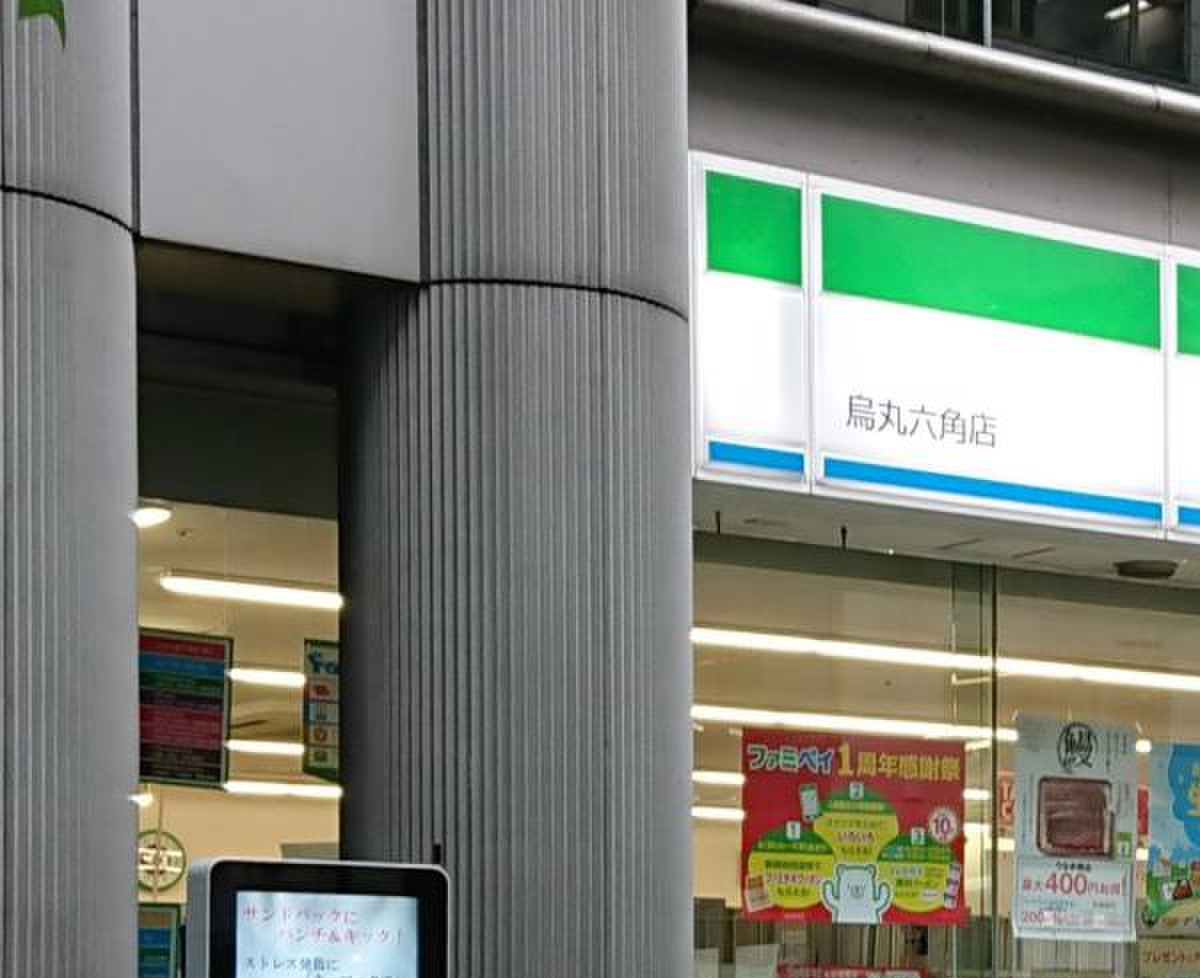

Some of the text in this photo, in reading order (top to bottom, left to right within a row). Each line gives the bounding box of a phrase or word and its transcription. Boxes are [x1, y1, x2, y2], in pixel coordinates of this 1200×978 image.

[845, 394, 998, 448] 烏丸六角店
